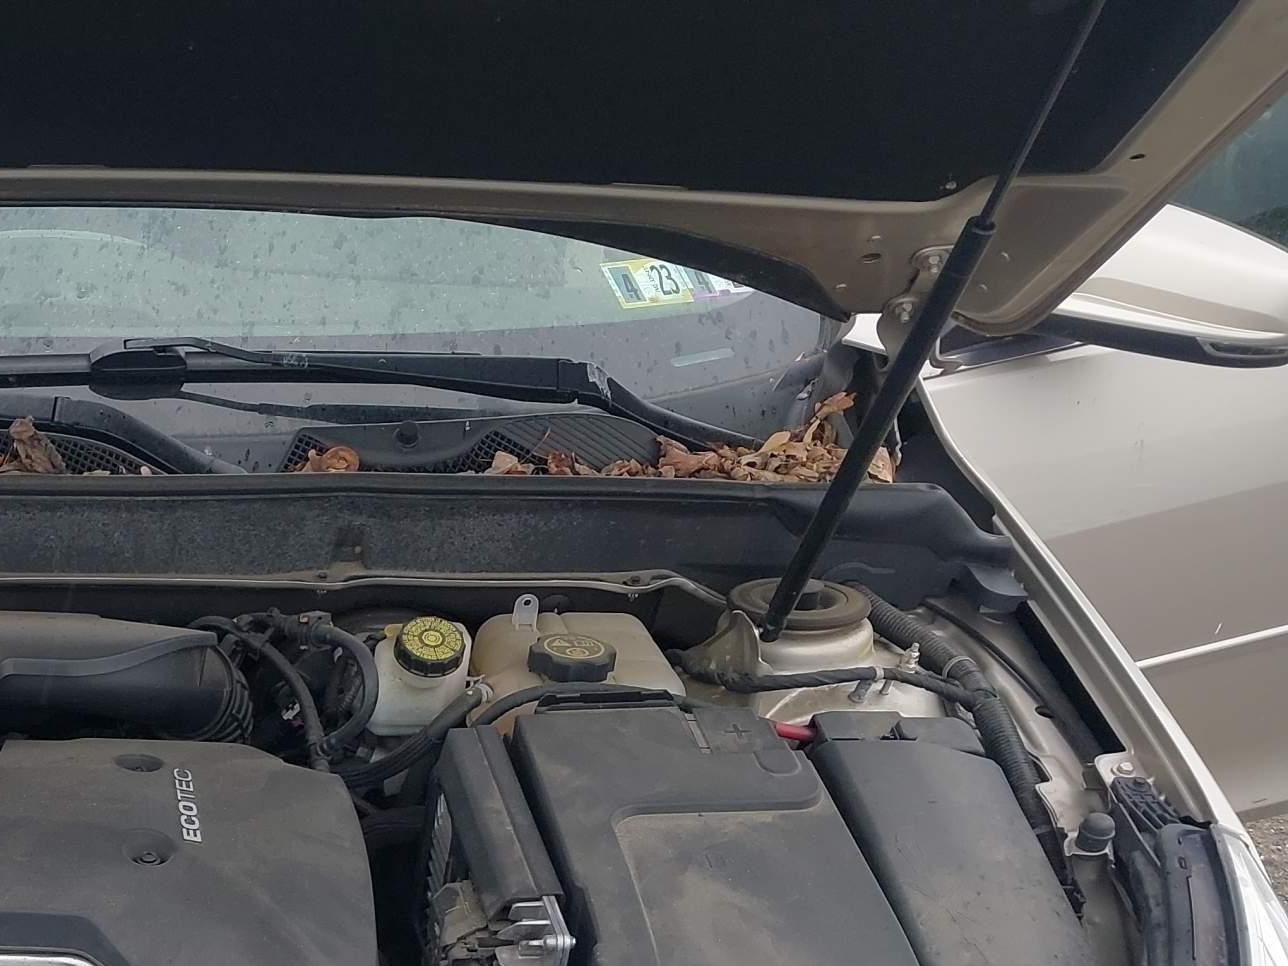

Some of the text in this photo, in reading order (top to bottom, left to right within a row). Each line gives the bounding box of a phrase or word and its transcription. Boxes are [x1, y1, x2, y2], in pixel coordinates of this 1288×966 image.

[621, 273, 641, 301] 4
[649, 264, 681, 296] 23
[173, 767, 203, 843] ECOTEC
